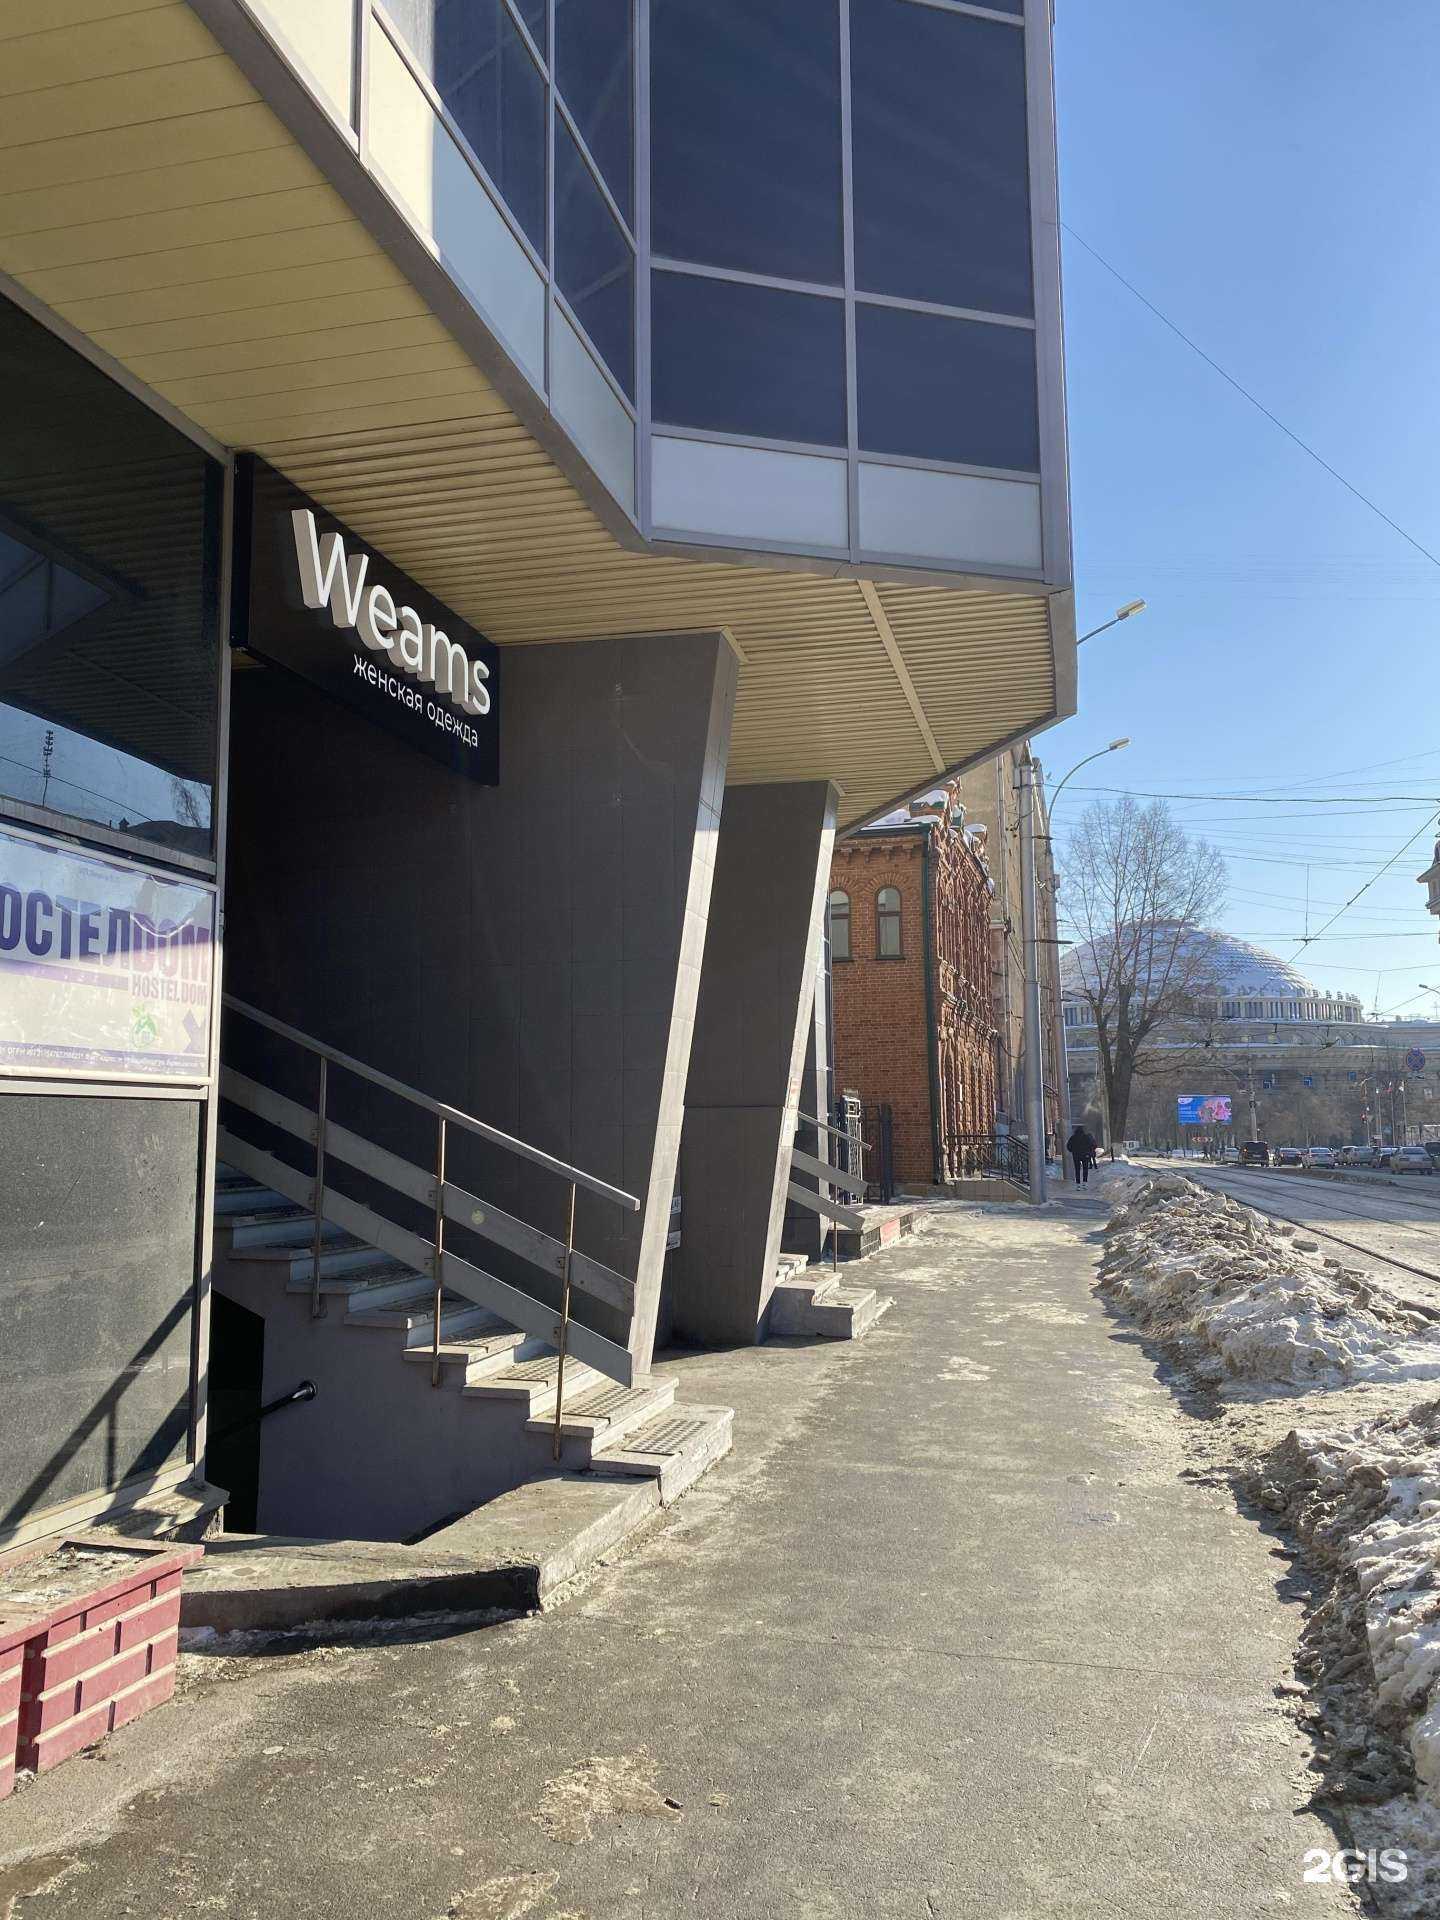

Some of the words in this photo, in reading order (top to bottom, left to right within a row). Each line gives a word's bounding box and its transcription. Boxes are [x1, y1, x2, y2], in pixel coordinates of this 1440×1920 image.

[291, 508, 491, 716] Weams
[353, 653, 423, 714] женская
[427, 702, 478, 748] одежда
